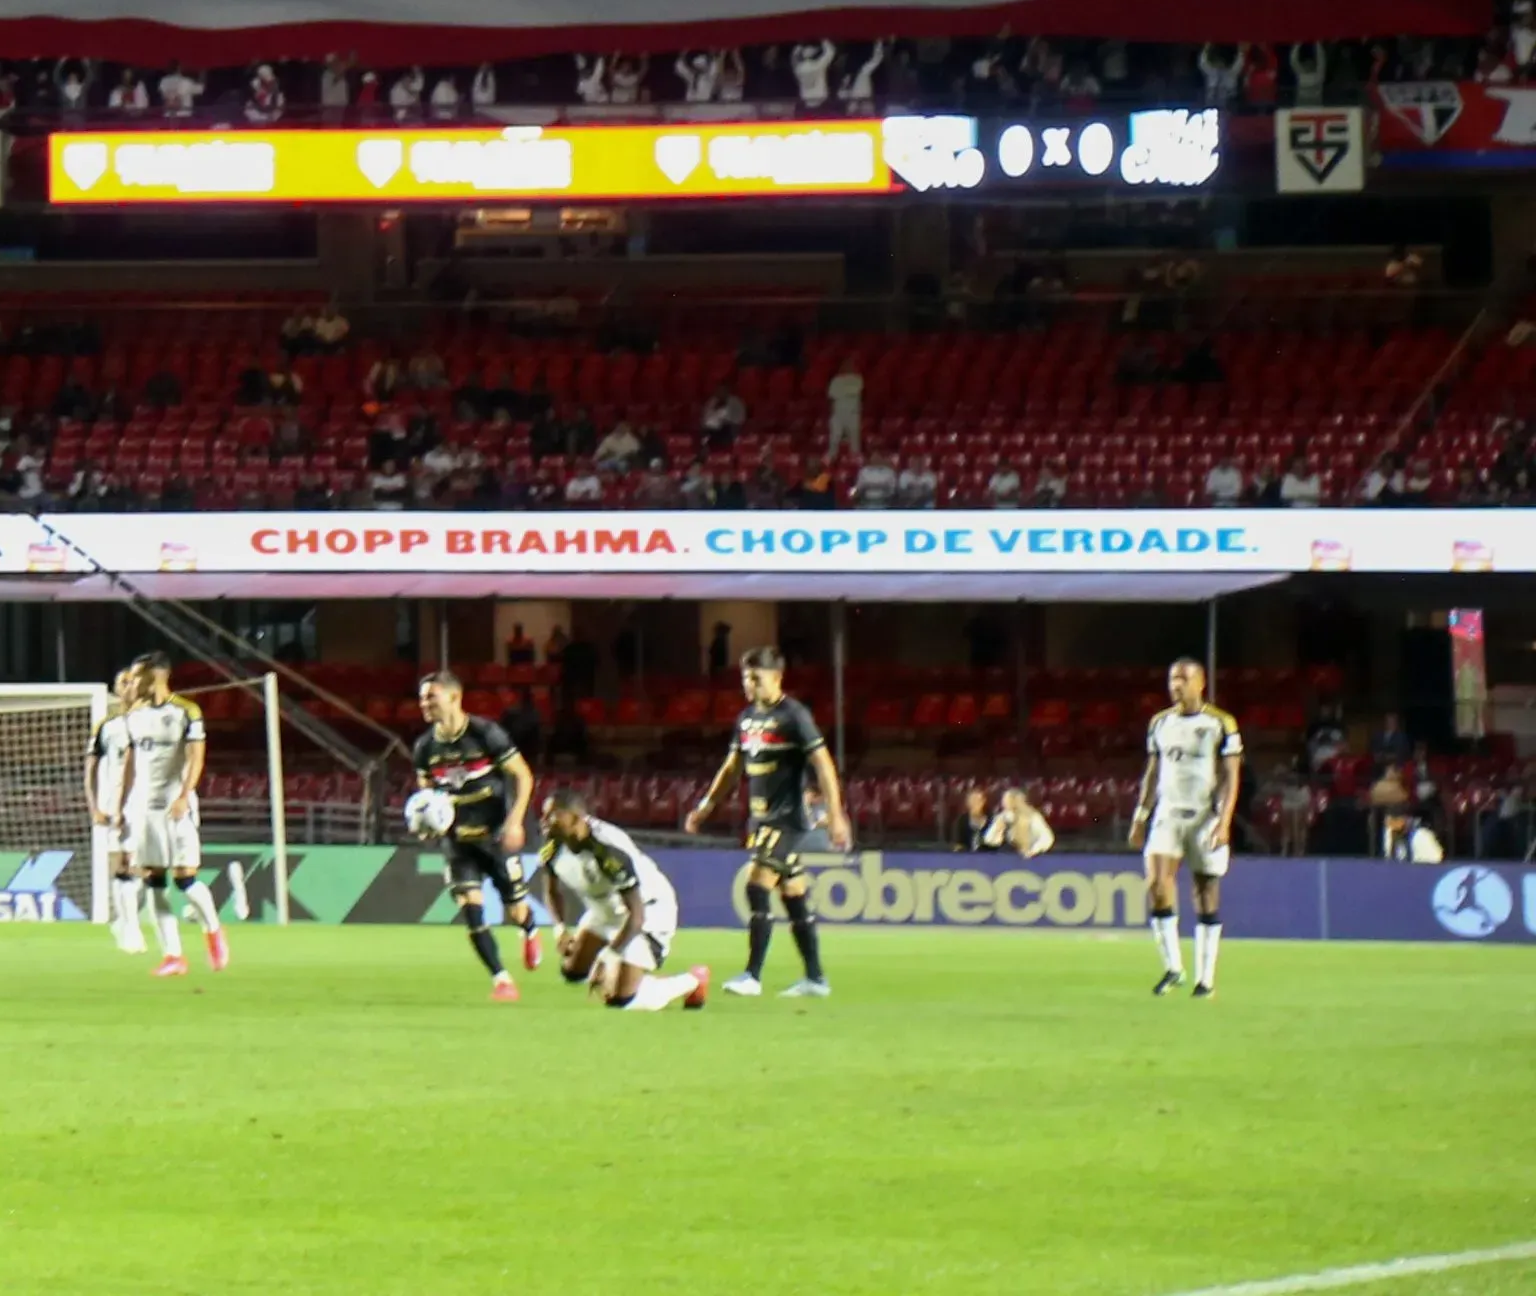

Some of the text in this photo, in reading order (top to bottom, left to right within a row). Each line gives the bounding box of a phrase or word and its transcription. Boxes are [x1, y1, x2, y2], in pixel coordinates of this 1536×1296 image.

[998, 124, 1034, 177] 0
[1078, 121, 1114, 176] 0
[251, 528, 1260, 553] CHOPP BRAHMA. CHOPP DE VERDADE.
